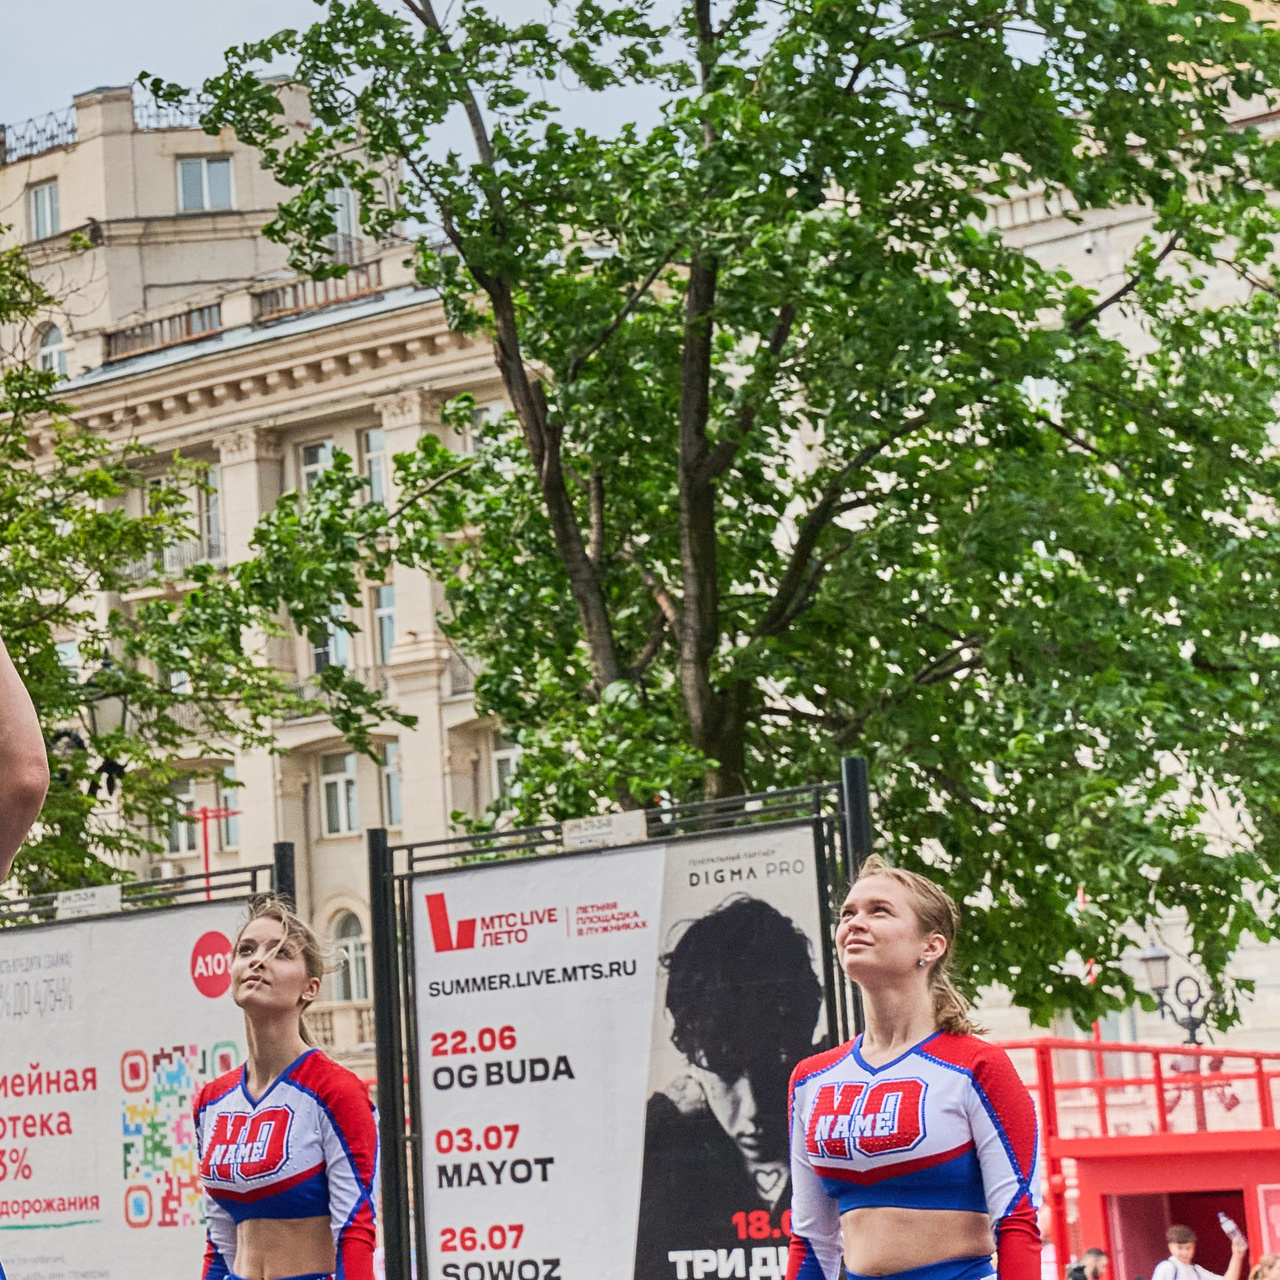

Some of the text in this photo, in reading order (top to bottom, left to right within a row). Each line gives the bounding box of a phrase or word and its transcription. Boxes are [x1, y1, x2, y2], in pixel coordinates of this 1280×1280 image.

[688, 858, 805, 887] DIGMA PRO
[520, 907, 558, 925] LIVE
[576, 910, 640, 926] ПЛОЩАДКА
[585, 919, 649, 936] ЛУЖНИКАХ
[481, 928, 528, 947] ЛЕТО
[428, 959, 638, 998] SUMMER.LIVE.MTS.RU
[430, 1025, 517, 1057] 22.06
[432, 1055, 575, 1091] OG BUDA
[804, 1076, 928, 1161] NO
[813, 1110, 894, 1142] NAME
[200, 1103, 295, 1184] NO
[208, 1140, 265, 1166] NAME
[435, 1124, 520, 1154] 03.07
[437, 1156, 555, 1189] MAYOT
[439, 1223, 524, 1253] 26.07
[441, 1257, 562, 1280] SOWOZ
[667, 1247, 747, 1280] ТРИ
